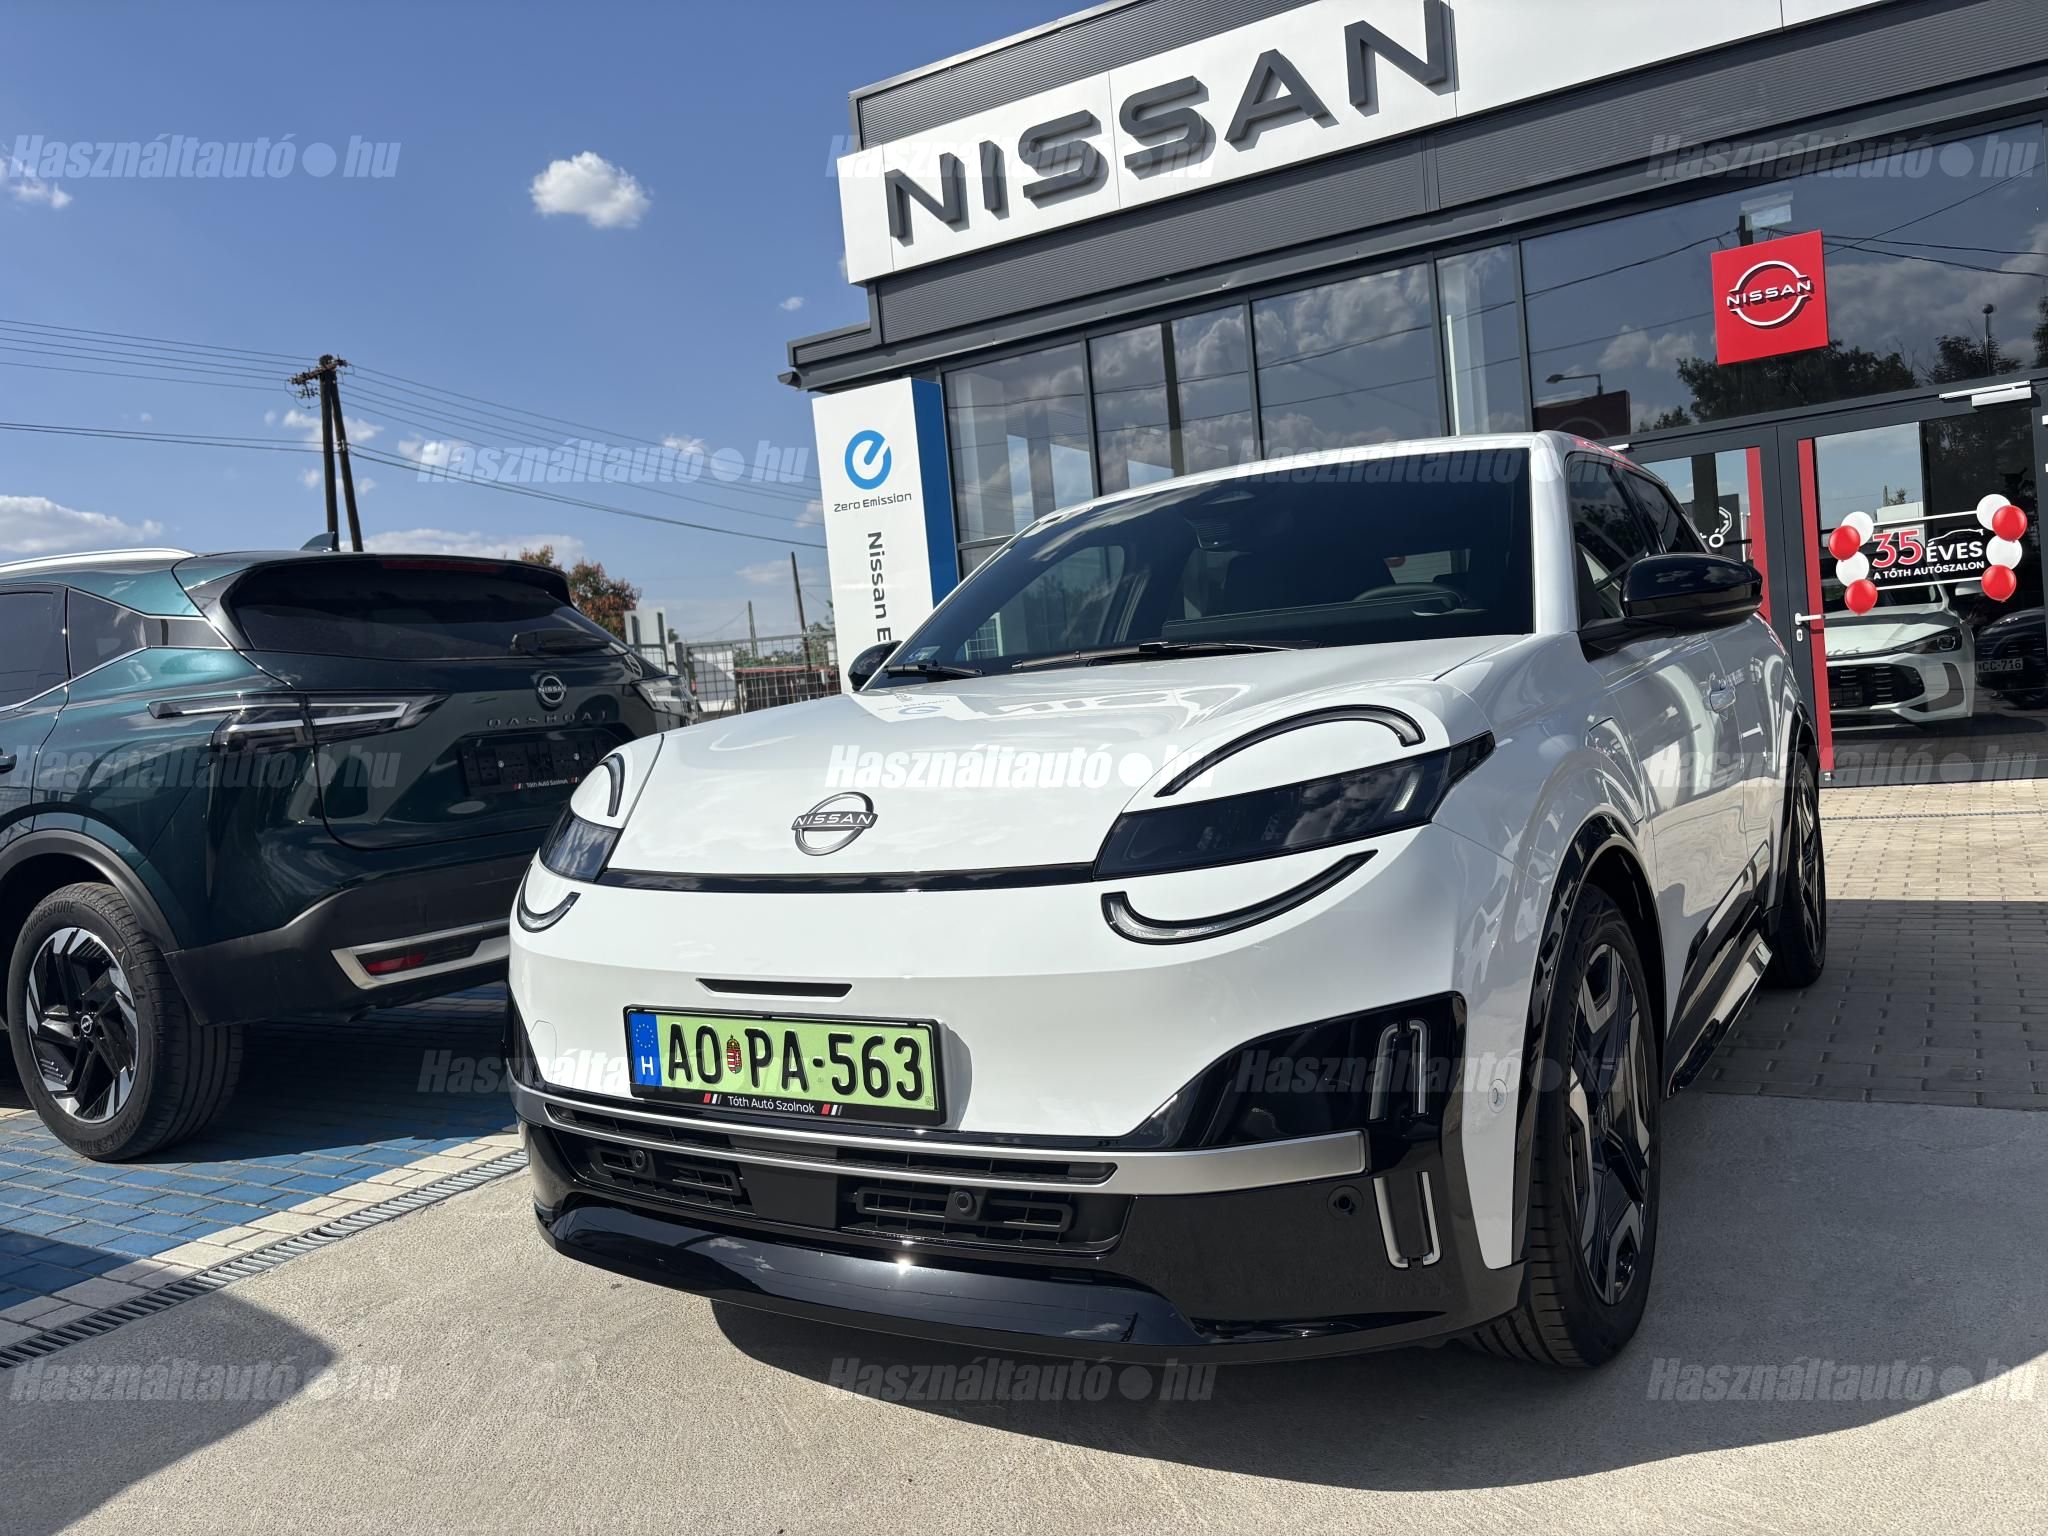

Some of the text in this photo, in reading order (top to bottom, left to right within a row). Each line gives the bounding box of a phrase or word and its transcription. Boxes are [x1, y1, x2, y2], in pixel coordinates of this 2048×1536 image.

[884, 0, 1450, 243] NISSAN
[1727, 280, 1811, 306] NISSAN
[834, 493, 912, 513] Zero Emission
[1872, 529, 1984, 569] 35 ÉVES
[868, 531, 888, 619] Nissan
[1873, 561, 1985, 581] A TÓTH AUTÓSZALON
[795, 813, 874, 827] NISSAN
[640, 1054, 655, 1077] H
[667, 1022, 924, 1101] AO PA-563
[727, 1095, 815, 1113] Tóth Autó Szolnok
